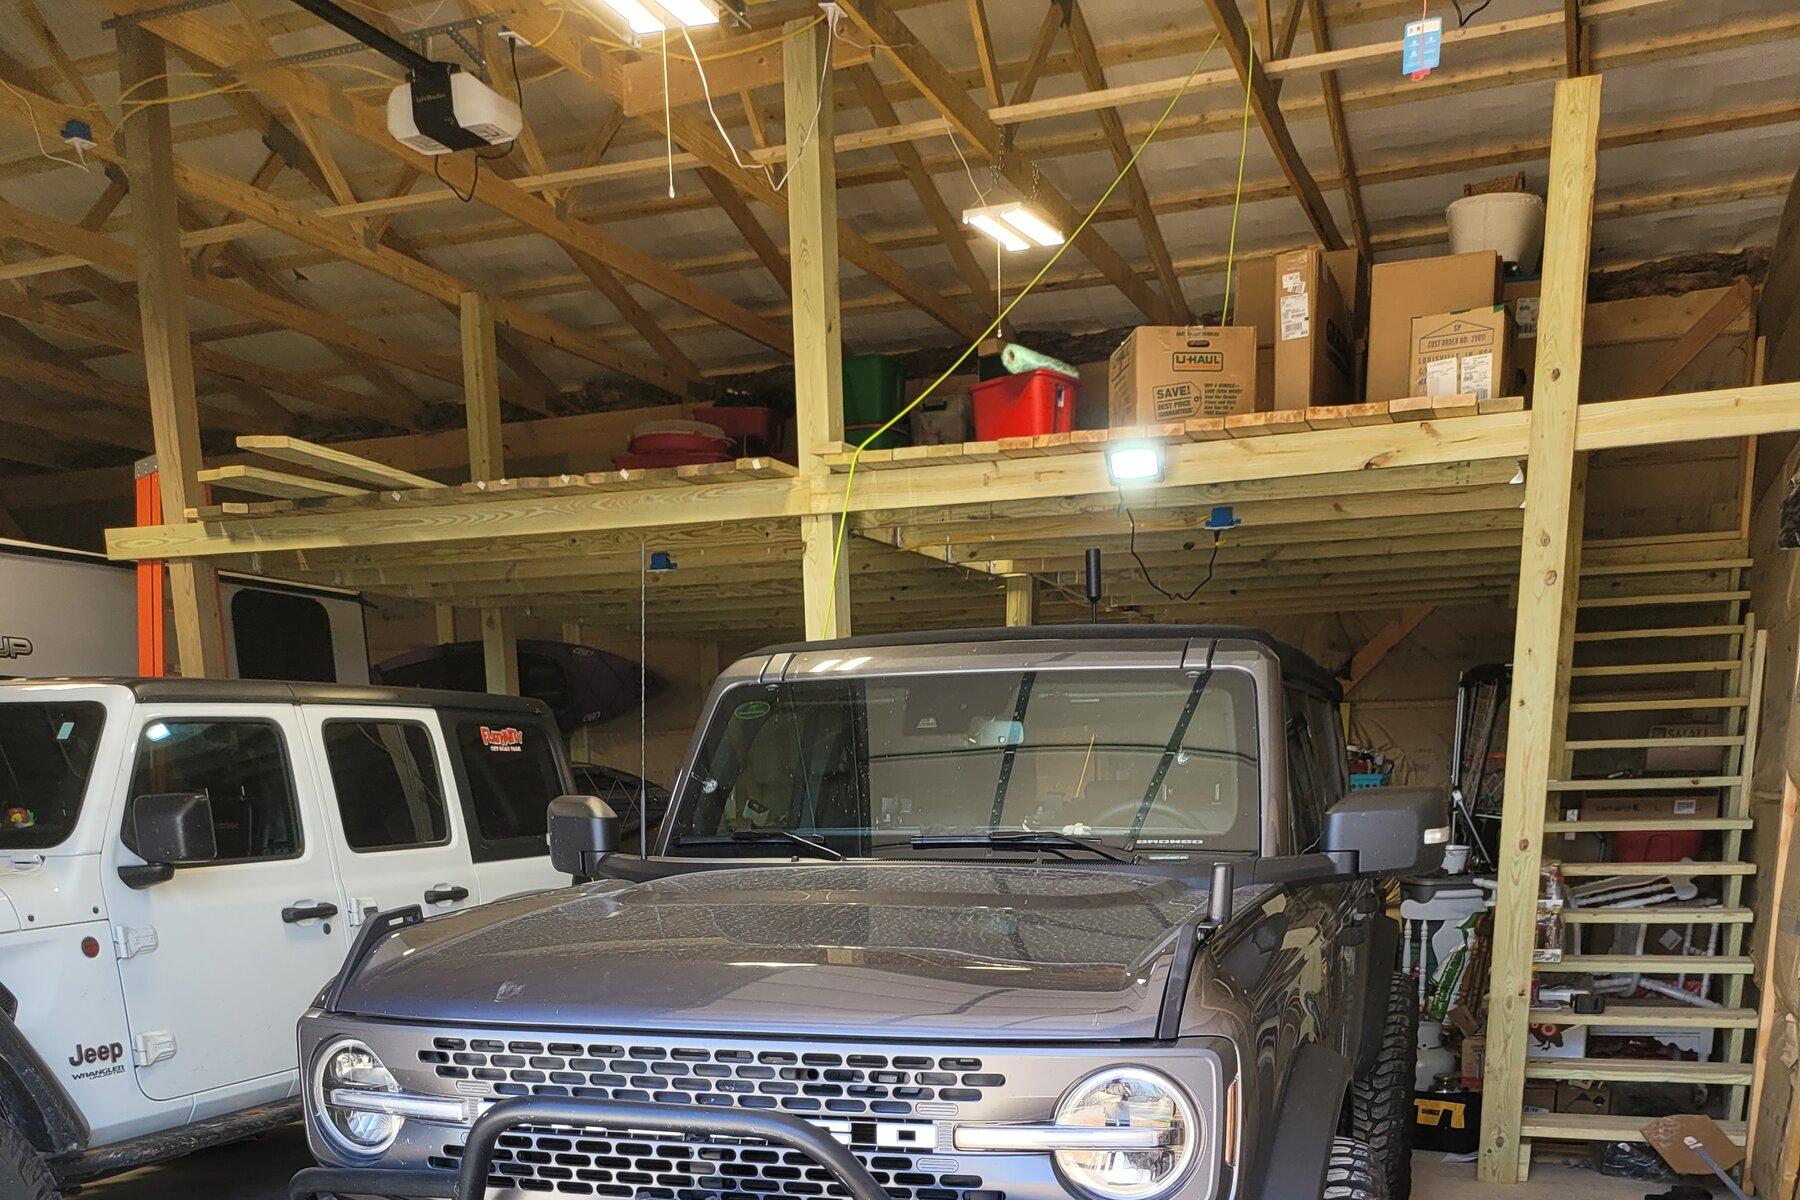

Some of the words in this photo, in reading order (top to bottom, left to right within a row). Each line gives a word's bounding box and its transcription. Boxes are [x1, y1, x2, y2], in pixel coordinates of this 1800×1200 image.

[1176, 355, 1220, 364] U-HAUL
[1157, 385, 1190, 399] SAVE!
[1158, 403, 1171, 411] BEST
[1174, 400, 1190, 409] PRICE
[68, 1042, 123, 1067] Jeep
[72, 1065, 125, 1080] WRANGLER
